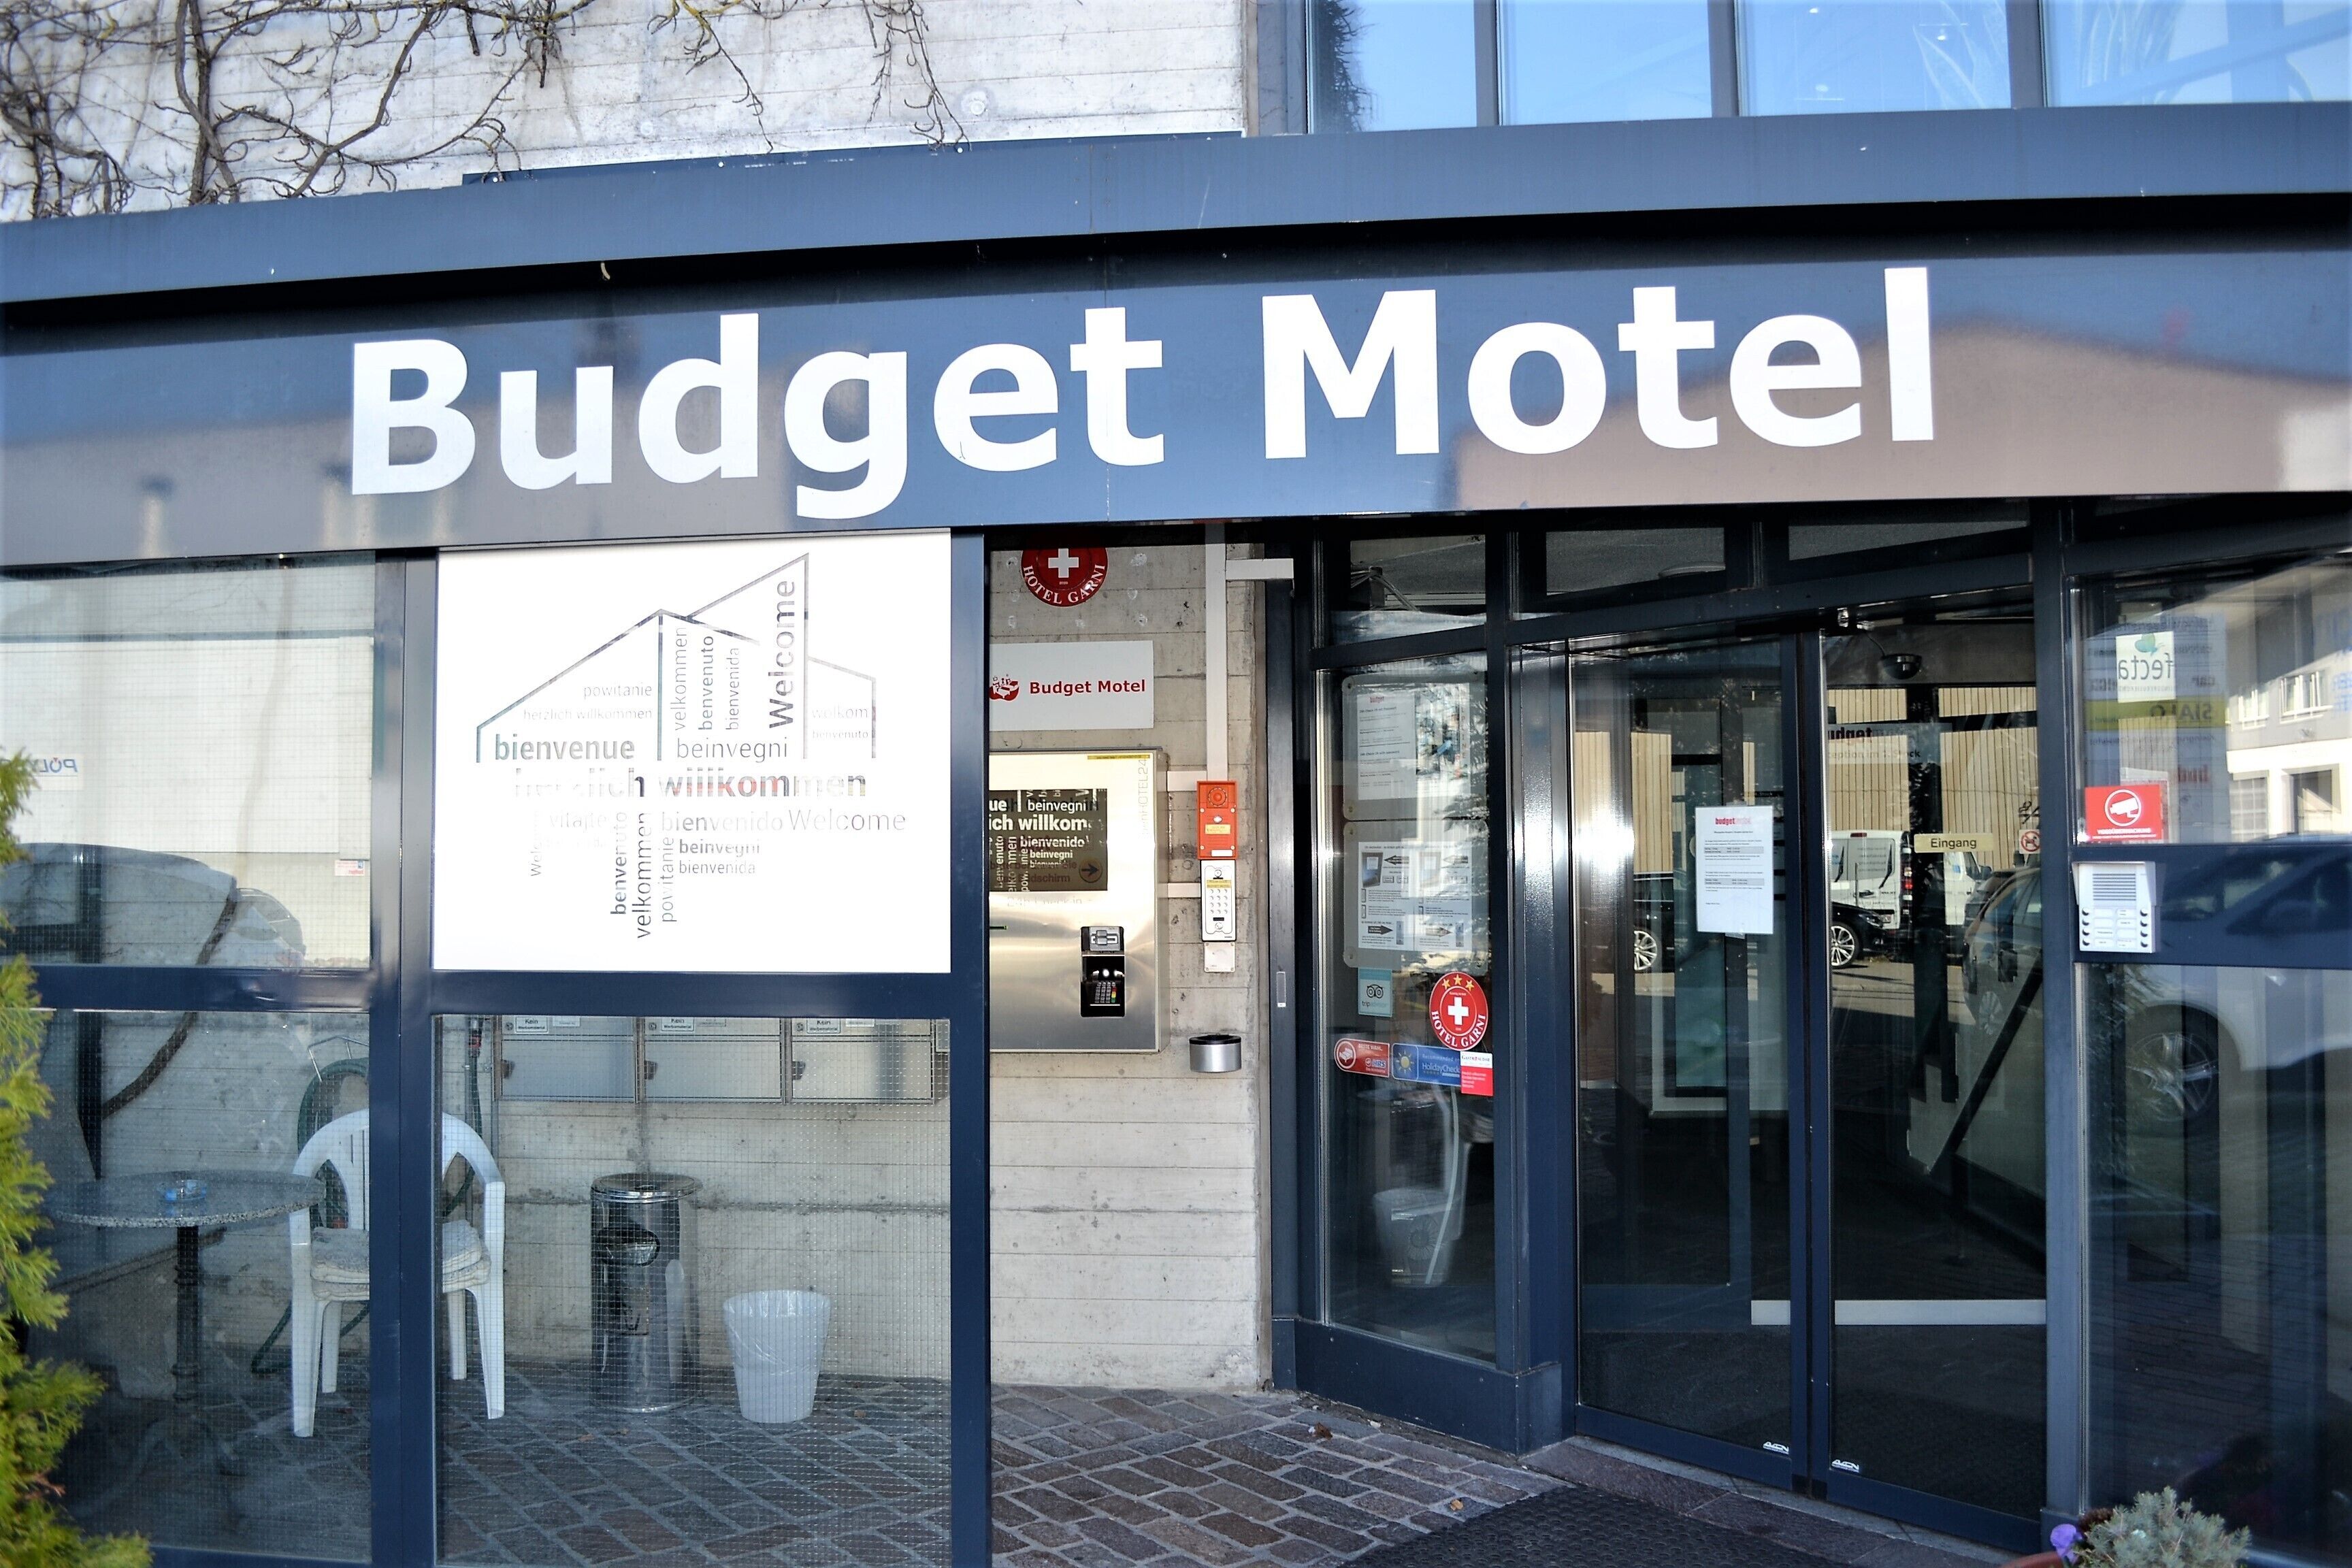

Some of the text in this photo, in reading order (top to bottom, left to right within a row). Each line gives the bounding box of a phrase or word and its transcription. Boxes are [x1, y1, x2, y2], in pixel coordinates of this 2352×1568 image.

[351, 267, 1935, 520] Budget Motel
[1023, 564, 1106, 604] HOTEL GARNI
[768, 581, 795, 728] Welcome
[584, 682, 653, 700] powitanie
[670, 627, 687, 731] velkommen
[698, 636, 714, 730] benvenuto
[725, 648, 740, 730] bienvenida
[1030, 679, 1145, 696] Budget Motel
[576, 708, 653, 719] willkommen
[495, 734, 636, 760] bienvenue
[677, 736, 787, 763] beinvegni
[657, 767, 866, 798] willkommen
[788, 808, 906, 831] Welcome
[1027, 799, 1087, 815] beinvegni
[661, 811, 783, 832] bienvenido
[679, 838, 760, 858] beinvegni
[1020, 835, 1085, 848] bienvenido
[1029, 849, 1073, 860] beinvegni
[1931, 838, 1977, 849] Eingang
[610, 812, 627, 915] benvenuto
[631, 812, 652, 939] velkommen
[679, 860, 756, 874] bienvenida
[657, 837, 677, 923] powitanie
[1431, 1011, 1486, 1047] HOTEL GARNI
